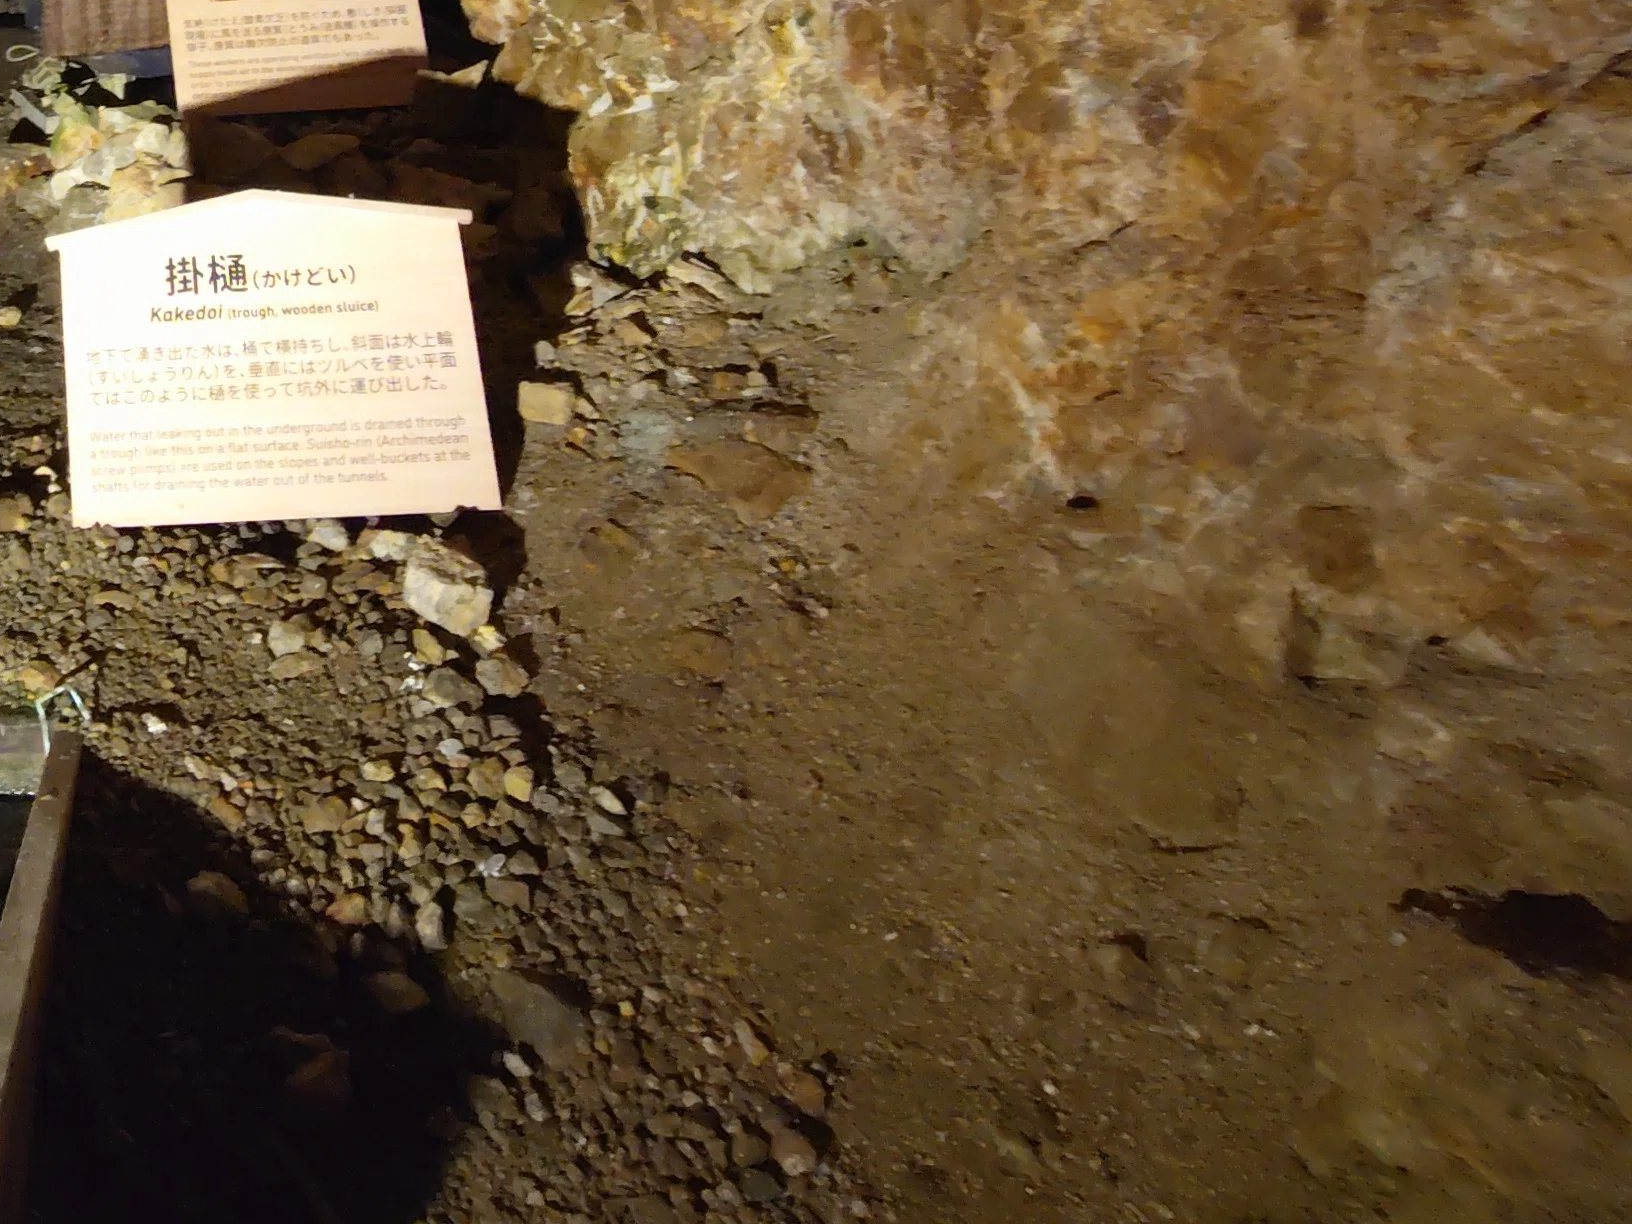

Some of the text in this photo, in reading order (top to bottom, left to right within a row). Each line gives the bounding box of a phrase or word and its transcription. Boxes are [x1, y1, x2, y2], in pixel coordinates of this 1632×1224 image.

[150, 304, 223, 323] Kakedoi
[281, 304, 333, 316] wooden
[336, 300, 380, 314] sluice)
[89, 431, 126, 443] Water
[129, 430, 154, 441] that
[205, 426, 225, 437] out
[243, 424, 263, 436] the
[266, 419, 347, 436] underground
[351, 421, 361, 431] is
[364, 417, 413, 431] drained
[416, 413, 466, 431] through
[90, 449, 97, 460] a
[100, 446, 140, 461] trough
[171, 444, 194, 456] this
[198, 444, 214, 455] on
[216, 443, 225, 454] a
[227, 441, 249, 453] flat
[91, 466, 126, 477] screw
[179, 462, 199, 473] are
[203, 460, 233, 472] used
[236, 460, 252, 471] on
[254, 458, 275, 470] the
[278, 456, 319, 471] slopes
[323, 454, 345, 467] and
[433, 451, 448, 462] at
[450, 448, 472, 461] the
[91, 480, 130, 493] shafts
[133, 479, 150, 492] for
[153, 478, 206, 493] draining
[209, 477, 229, 489] the
[233, 476, 270, 488] water
[273, 474, 294, 487] out
[298, 473, 310, 485] of
[313, 472, 335, 484] the
